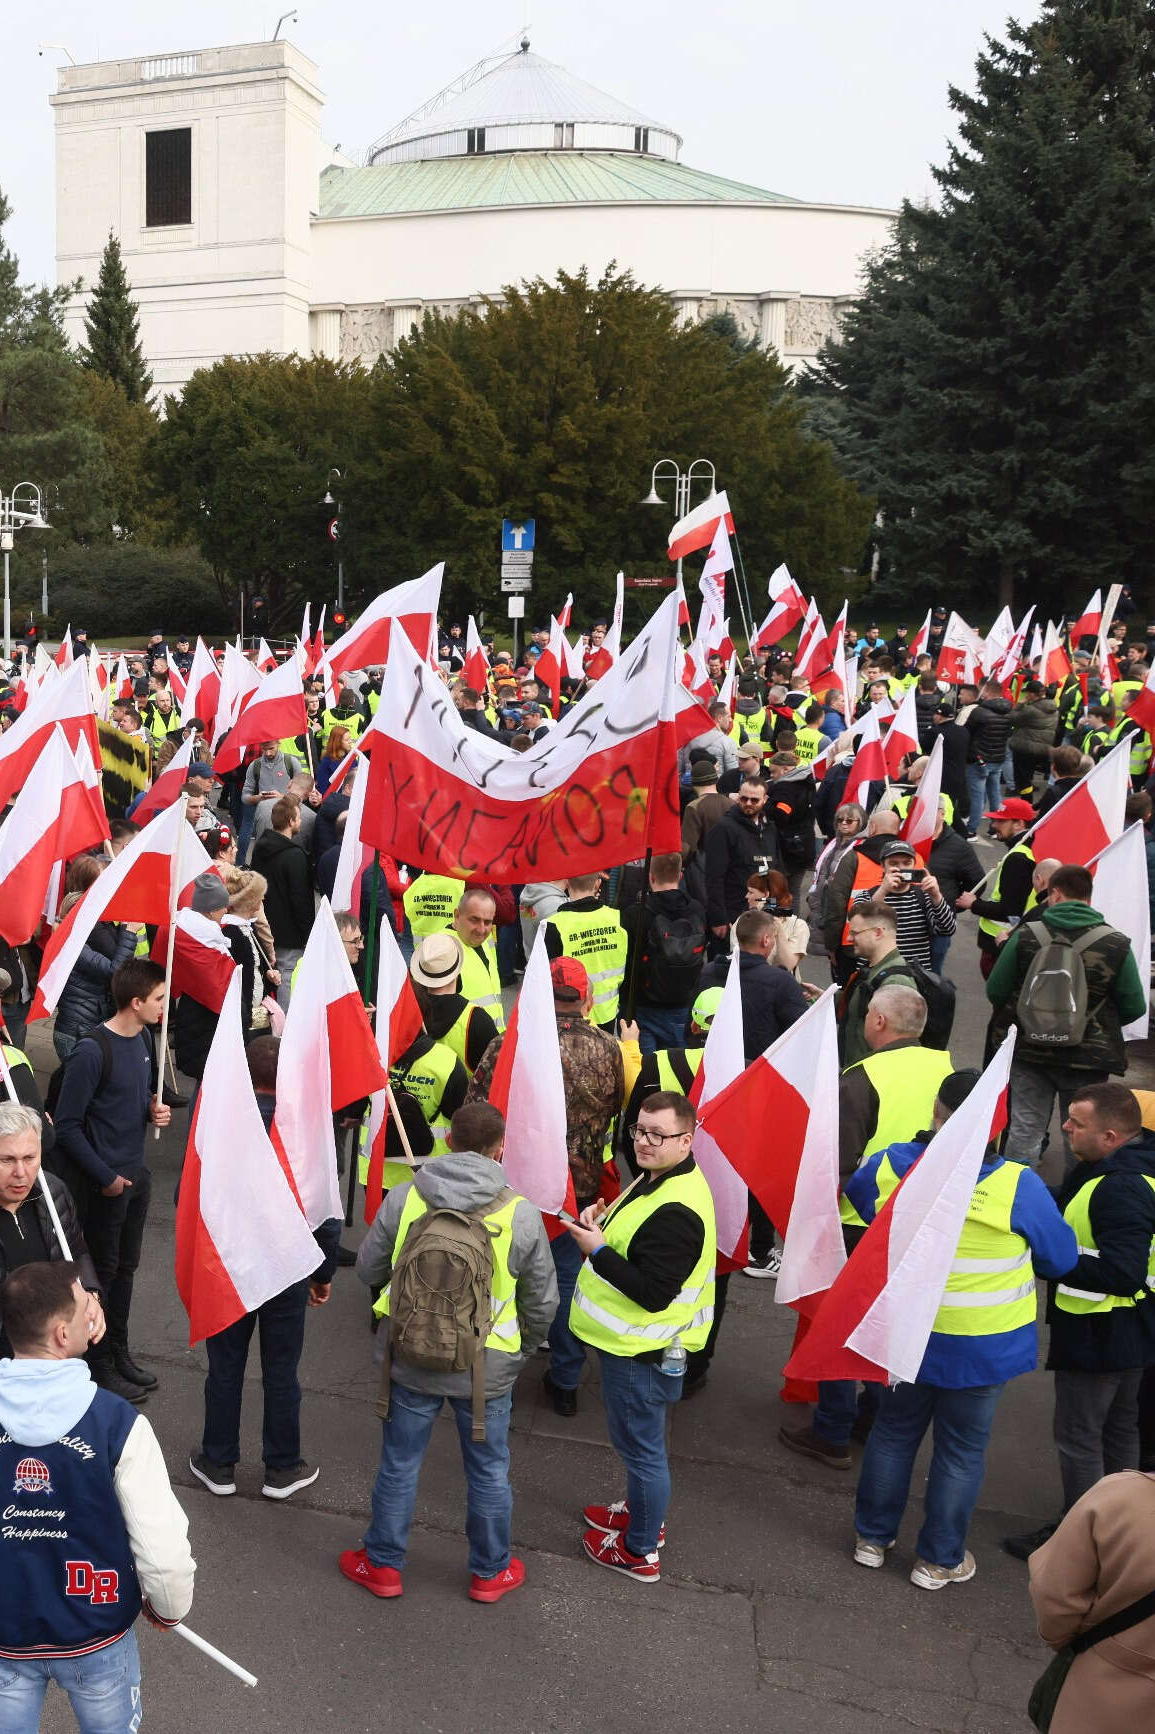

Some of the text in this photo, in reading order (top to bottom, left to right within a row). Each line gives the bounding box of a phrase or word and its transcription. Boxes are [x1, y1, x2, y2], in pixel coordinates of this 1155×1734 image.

[795, 739, 814, 750] OLNIK
[794, 749, 813, 759] OLSKI
[569, 926, 617, 942] GR-WIECZOREK
[1030, 1032, 1069, 1042] adidas
[58, 1435, 97, 1460] ality
[2, 1504, 66, 1521] Constancy
[1, 1525, 69, 1541] Happiness
[66, 1560, 119, 1605] DR
